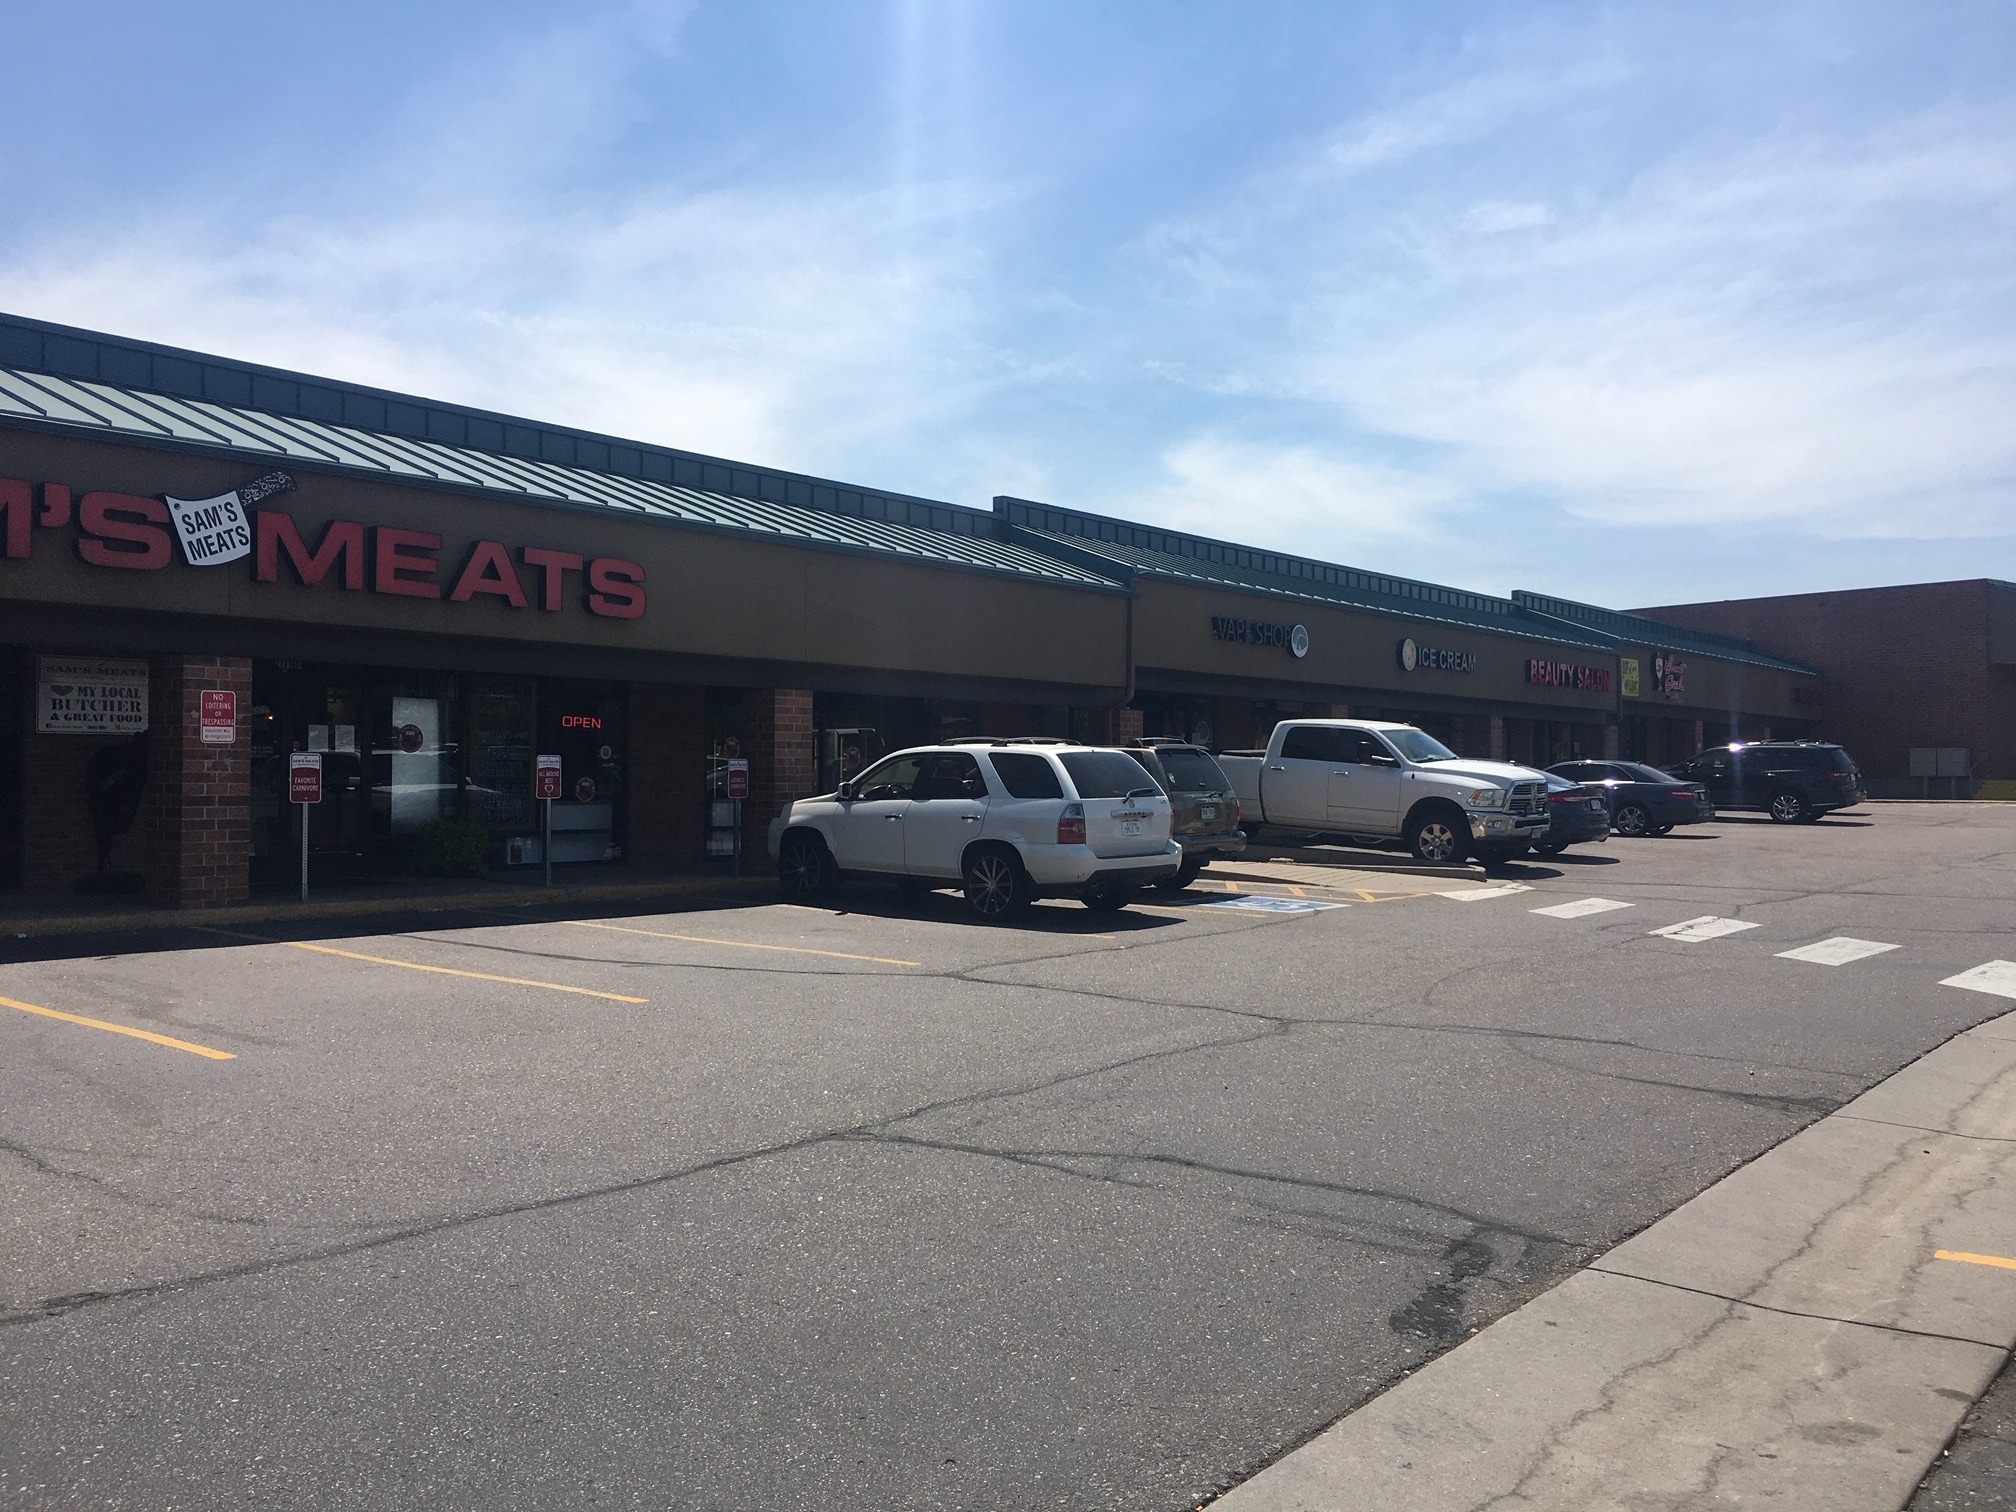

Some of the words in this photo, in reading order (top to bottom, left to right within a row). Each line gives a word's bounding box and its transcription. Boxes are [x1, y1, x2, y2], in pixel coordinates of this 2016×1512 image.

[181, 501, 238, 535] SAM'S
[187, 525, 250, 561] MEATS
[256, 510, 647, 620] MEATS
[1216, 616, 1252, 643] VAPE
[1255, 621, 1291, 647] SHOP
[1418, 646, 1437, 668] ICE
[1439, 649, 1477, 672] CREAM
[1530, 658, 1575, 687] BEAUTY
[1577, 666, 1612, 692] SALON
[77, 685, 96, 698] MY
[101, 686, 142, 699] LOCAL
[213, 693, 224, 701] NO
[51, 698, 142, 712] BUTCHER
[205, 702, 231, 710] LOITERING
[50, 712, 60, 721] &
[63, 713, 106, 722] GREAT
[109, 714, 143, 723] FOOD
[202, 717, 235, 726] TRESPASSING
[562, 715, 602, 729] OPEN
[292, 784, 319, 792] CARNIVORE
